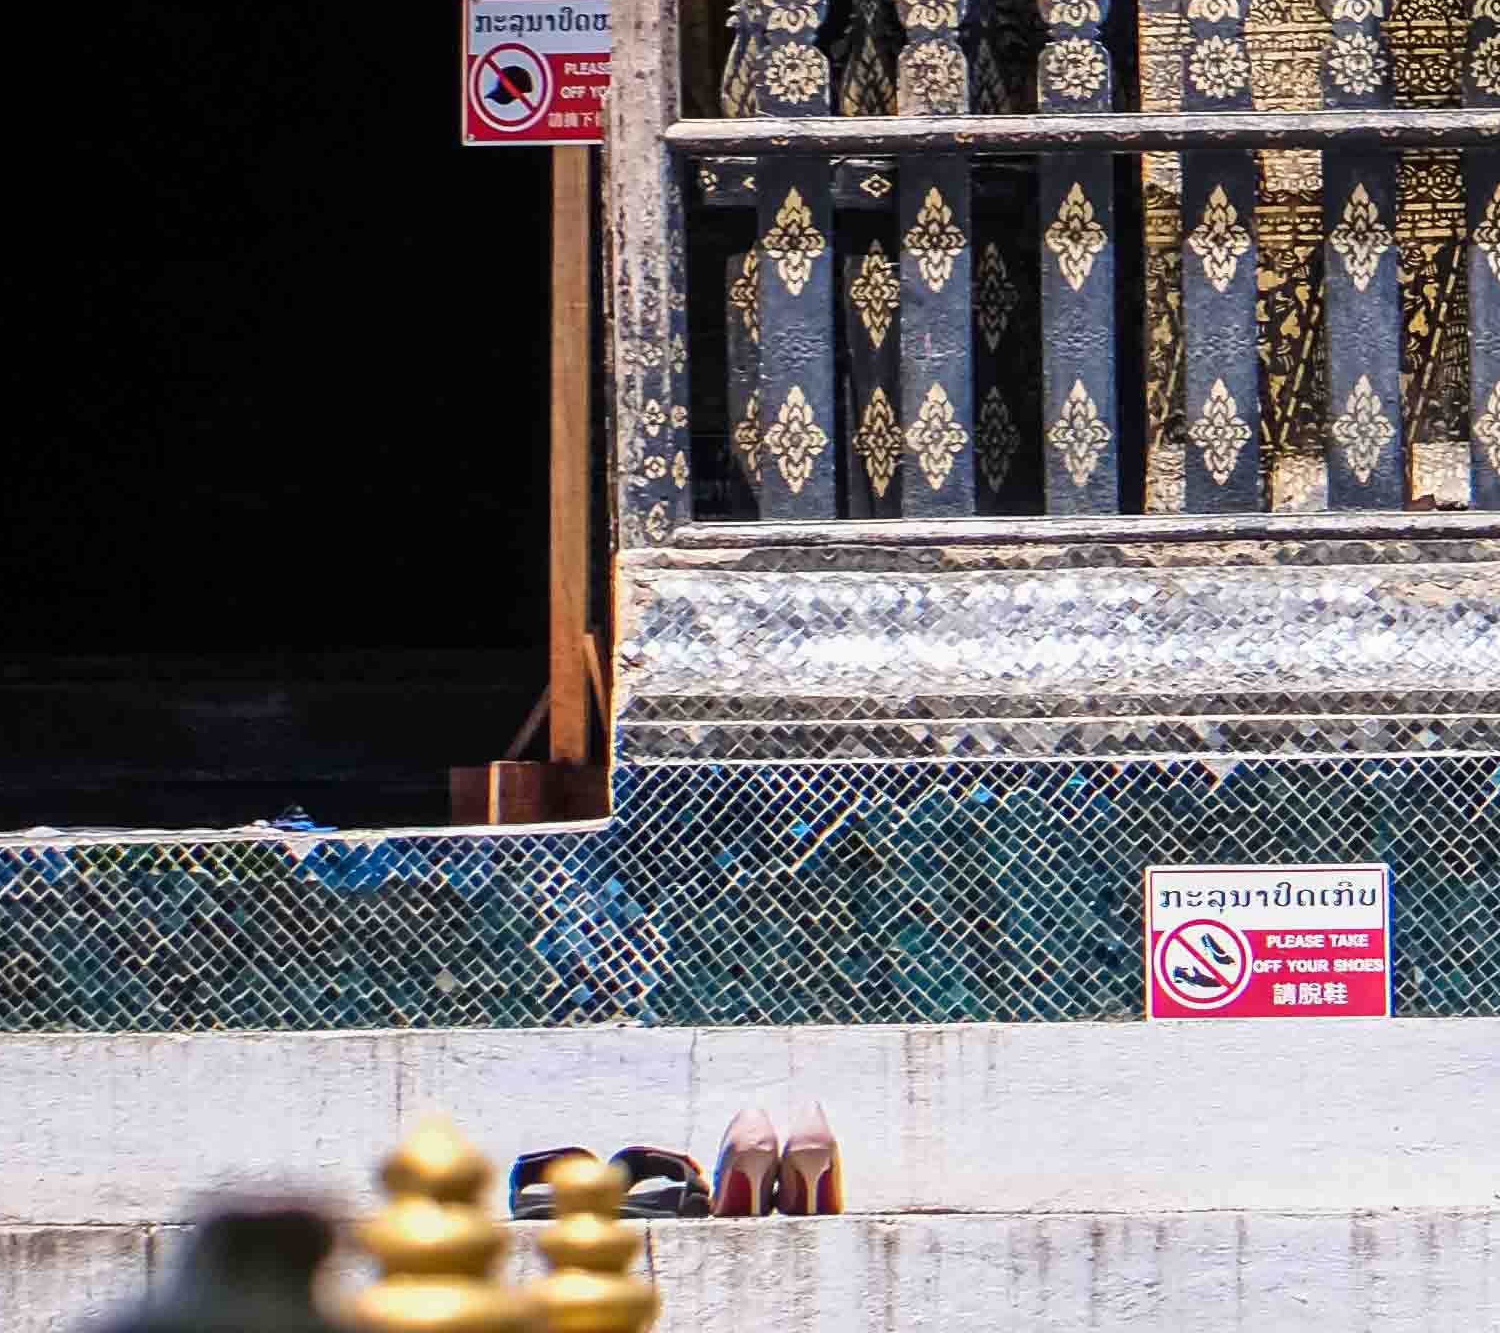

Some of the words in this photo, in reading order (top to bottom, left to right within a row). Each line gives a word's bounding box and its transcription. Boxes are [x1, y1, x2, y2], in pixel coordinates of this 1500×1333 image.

[560, 85, 586, 99] OFF
[1266, 934, 1325, 948] PLEASE
[1328, 934, 1369, 948] TAKE
[1252, 959, 1282, 973] OFF
[1286, 959, 1330, 973] YOUR
[1333, 958, 1384, 973] SHOES
